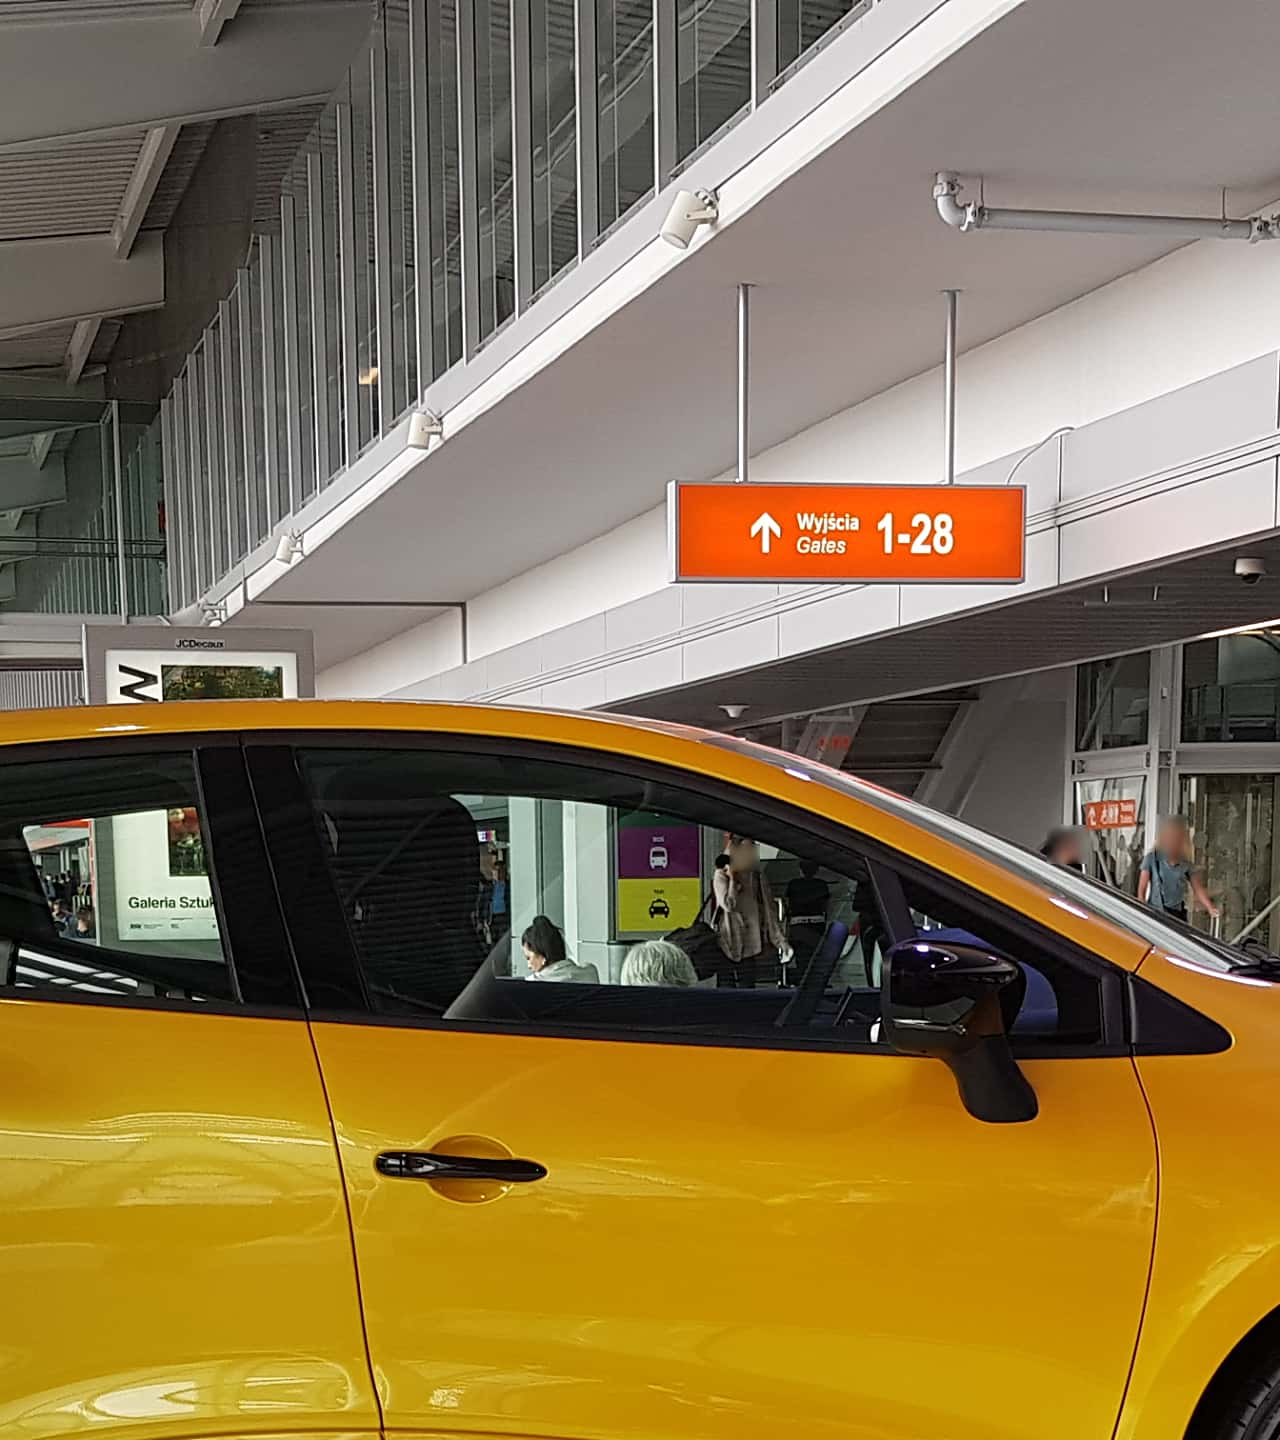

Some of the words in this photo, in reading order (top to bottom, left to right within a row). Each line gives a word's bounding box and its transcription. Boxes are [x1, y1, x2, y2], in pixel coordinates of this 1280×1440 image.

[796, 512, 860, 535] Wyjścia
[877, 512, 954, 555] 1-28
[796, 536, 847, 555] Gates
[175, 639, 225, 649] JCDecaux
[128, 896, 176, 909] Galeria
